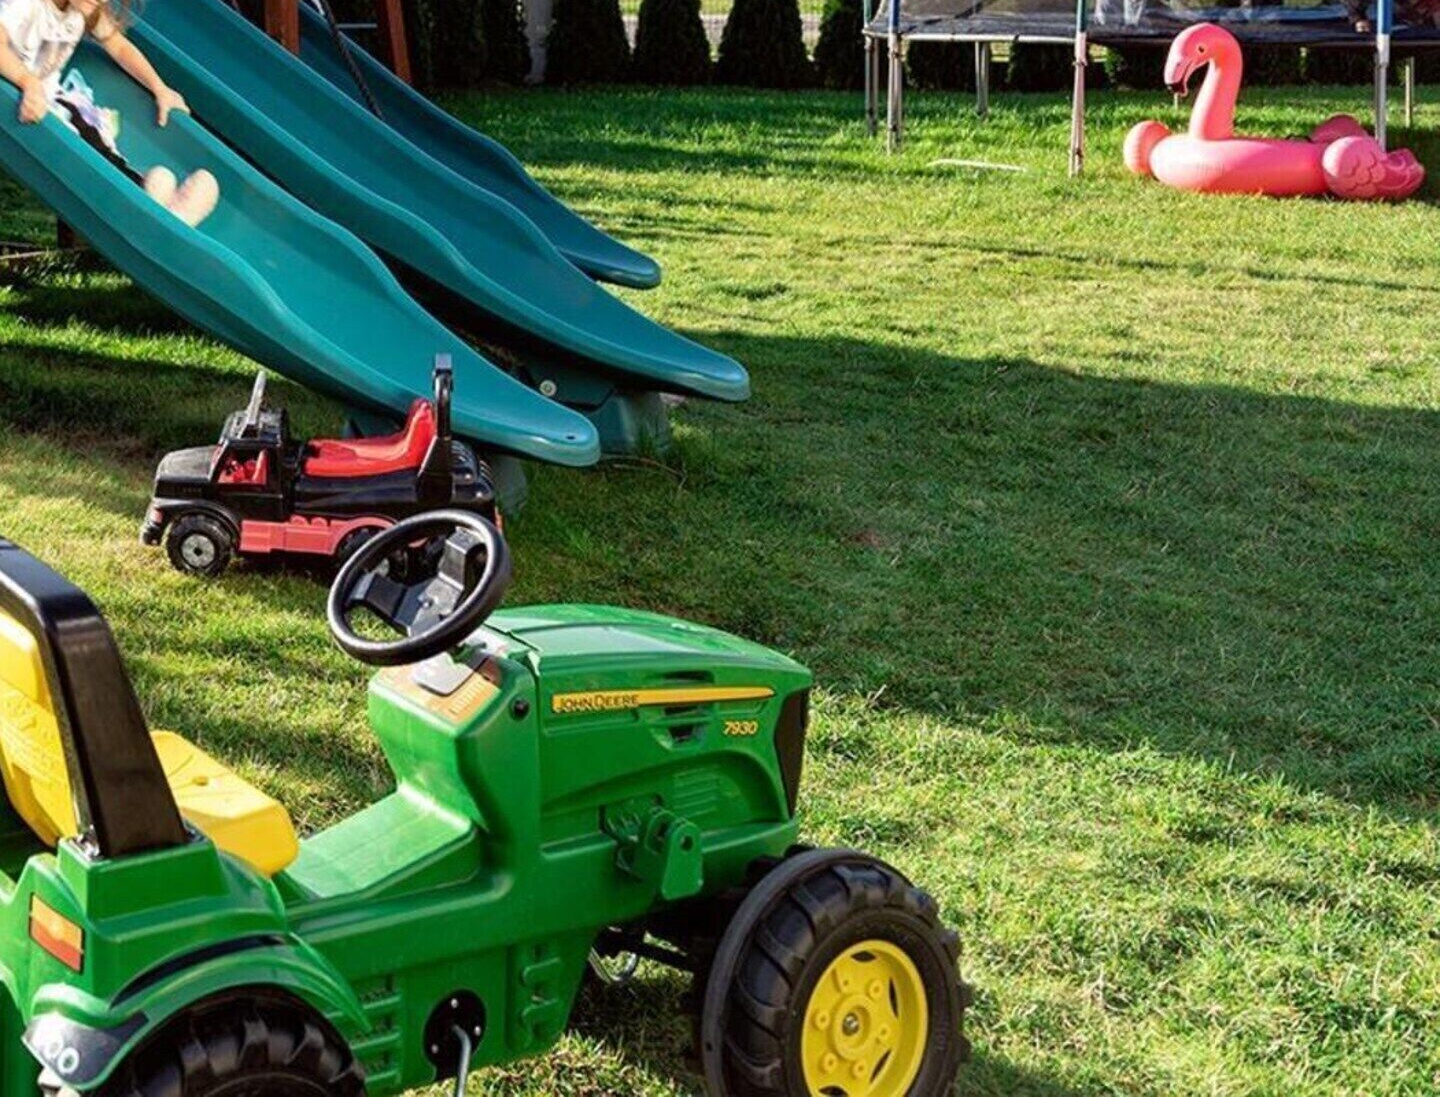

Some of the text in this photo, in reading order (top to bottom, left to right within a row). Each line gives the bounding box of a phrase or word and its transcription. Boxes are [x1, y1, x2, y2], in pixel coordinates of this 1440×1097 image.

[558, 693, 639, 711] JOHN DEERE
[723, 720, 758, 735] 7930
